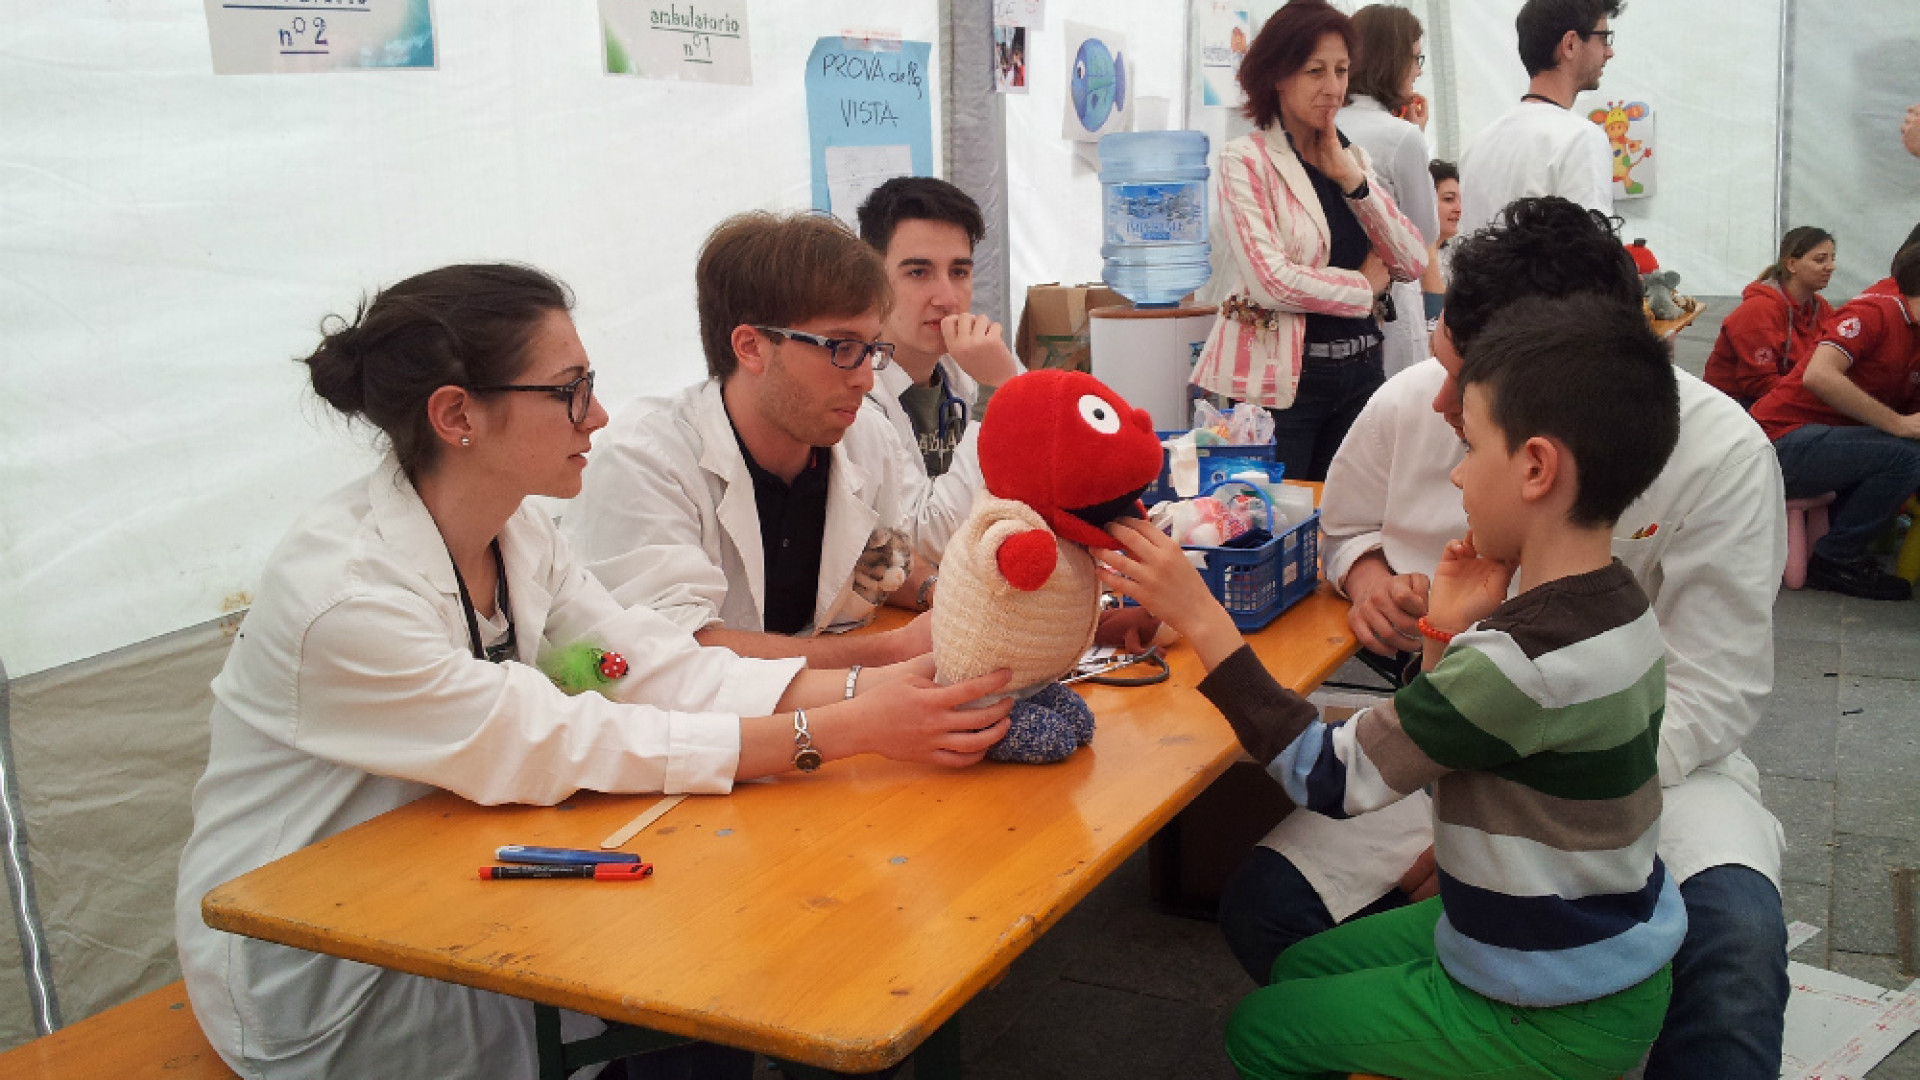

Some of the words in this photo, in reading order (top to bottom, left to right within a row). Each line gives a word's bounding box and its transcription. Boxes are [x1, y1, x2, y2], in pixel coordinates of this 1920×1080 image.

[650, 3, 740, 32] ambulatorio
[823, 53, 885, 82] PROVA
[841, 98, 899, 128] VISTA
